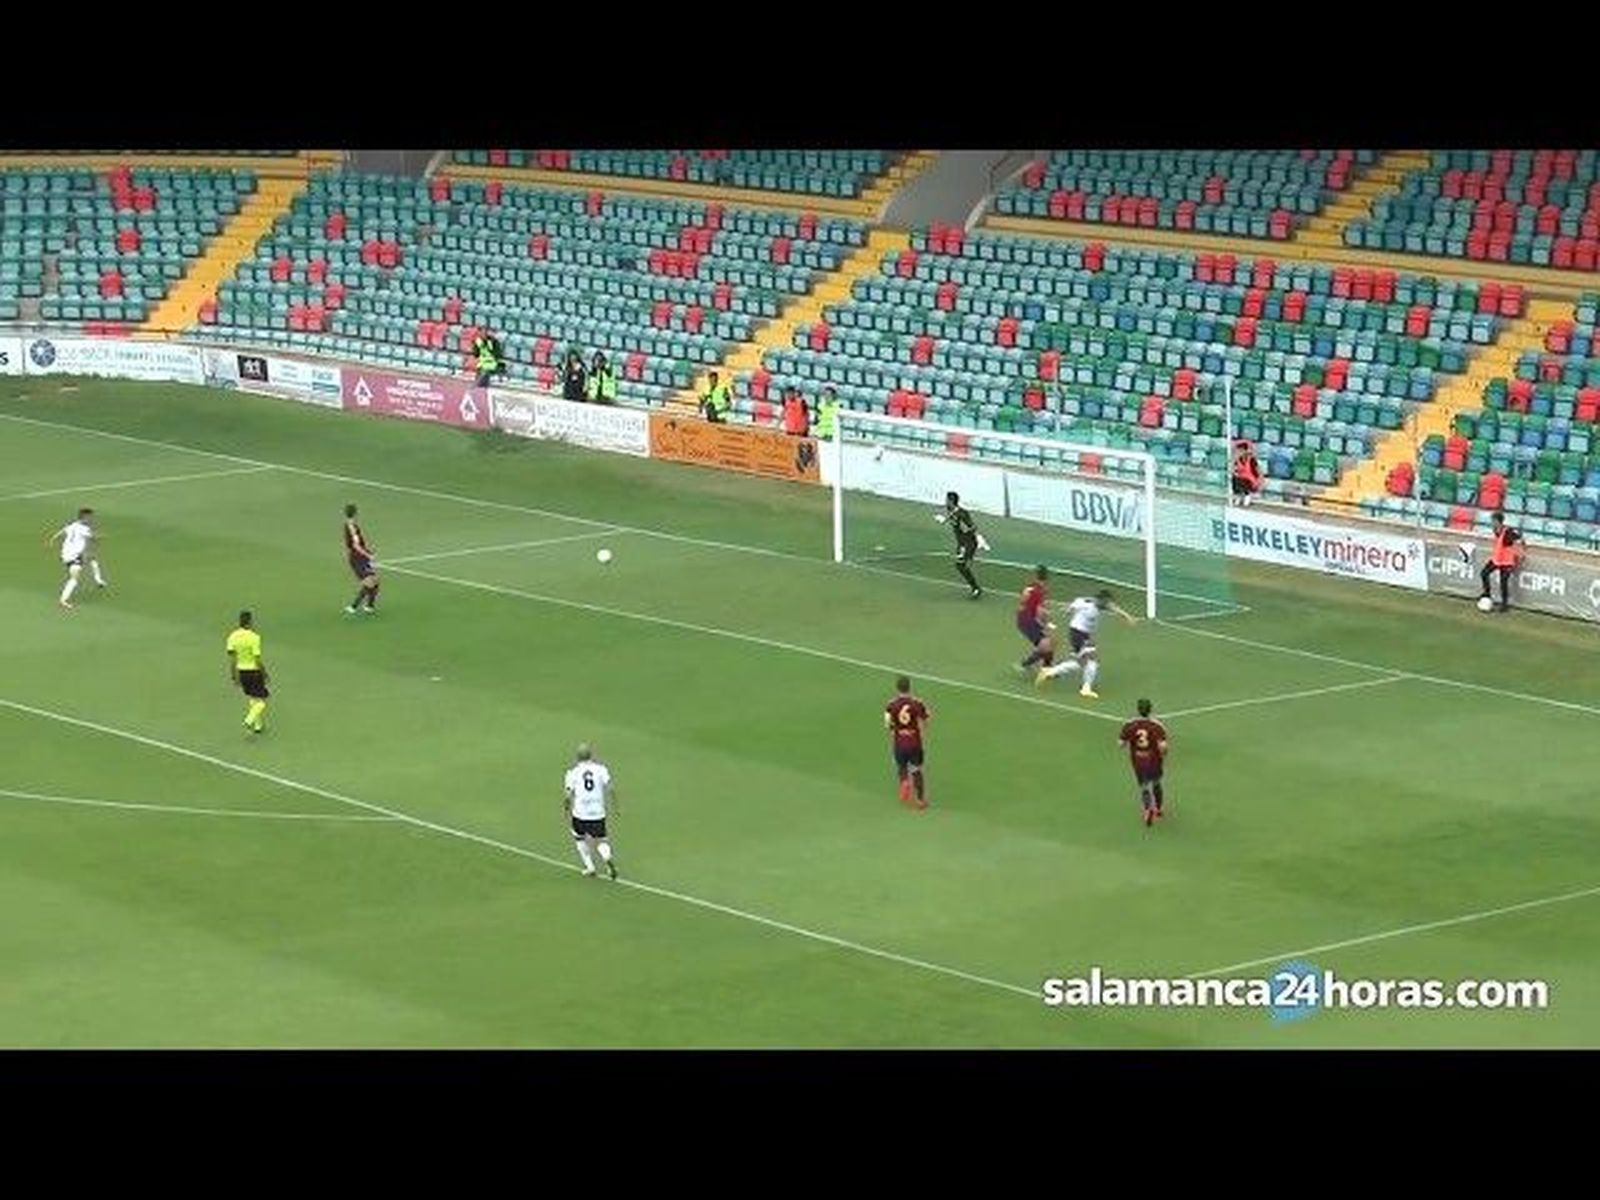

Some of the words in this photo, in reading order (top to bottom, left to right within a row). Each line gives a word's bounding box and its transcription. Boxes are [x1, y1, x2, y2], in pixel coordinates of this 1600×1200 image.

[1518, 571, 1566, 596] CIPA
[897, 704, 911, 725] 6
[1135, 728, 1149, 748] 3
[582, 769, 595, 792] 6
